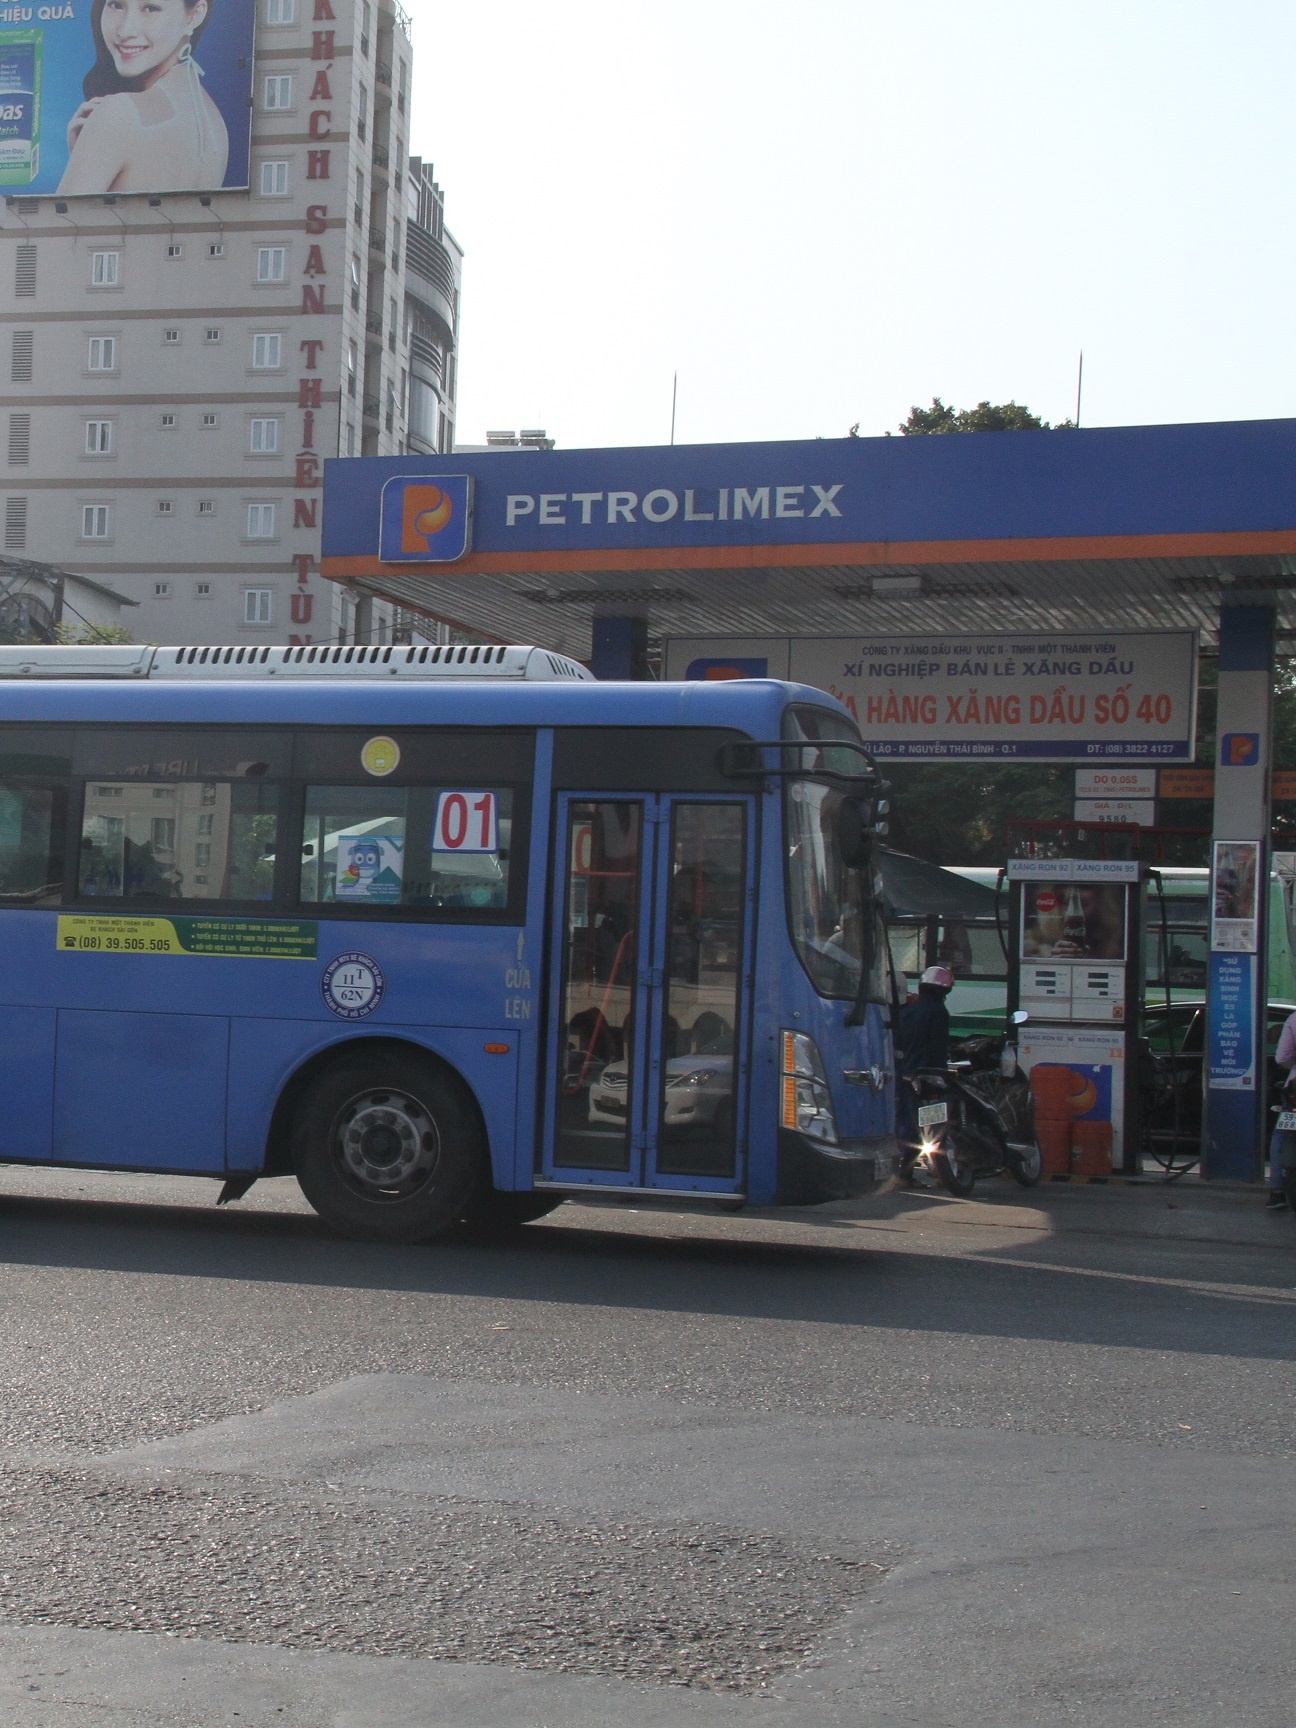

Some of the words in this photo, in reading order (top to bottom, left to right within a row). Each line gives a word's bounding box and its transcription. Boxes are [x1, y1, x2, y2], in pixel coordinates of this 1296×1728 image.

[37, 2, 75, 20] QUẢ
[505, 484, 845, 526] PETROLIMEX
[862, 644, 887, 656] CÔNG
[889, 645, 901, 655] TY
[903, 643, 928, 655] XĂNG
[931, 643, 952, 655] DẦU
[953, 645, 972, 655] KHU
[1011, 645, 1036, 655] TNHH
[1037, 642, 1057, 656] MỘT
[1060, 642, 1088, 655] THÀNH
[1091, 642, 1116, 654] VIÊN
[843, 660, 862, 677] XÍ
[868, 660, 941, 680] NGHIỆP
[947, 657, 987, 677] BÁN
[993, 656, 1016, 676] LẺ
[1022, 657, 1082, 676] XĂNG
[1088, 656, 1134, 675] DẦU
[867, 688, 937, 725] HÀNG
[946, 688, 1021, 725] XĂNG
[1029, 684, 1084, 724] DẦU
[1094, 682, 1132, 724] SỐ
[1135, 693, 1172, 724] 40
[873, 742, 892, 754] LÃO
[908, 741, 947, 754] NGUYỄN
[949, 742, 970, 754] THÁI
[972, 742, 994, 754] BÌNH
[1001, 744, 1017, 754] Q.1
[1087, 744, 1104, 754] ĐT:
[1105, 743, 1123, 756] (08)
[1124, 743, 1148, 754] 3822
[1150, 743, 1174, 753] 4127
[1094, 775, 1108, 784] DO
[441, 793, 492, 849] 01
[1012, 862, 1035, 871] XĂNG
[1077, 863, 1101, 872] XĂNG
[1103, 864, 1122, 872] RON
[1124, 865, 1134, 873] 95
[79, 935, 102, 949] (08)
[106, 937, 171, 951] 39.505.505
[505, 961, 531, 988] CỬA
[341, 990, 364, 1001] 62N
[505, 994, 531, 1019] LÊN
